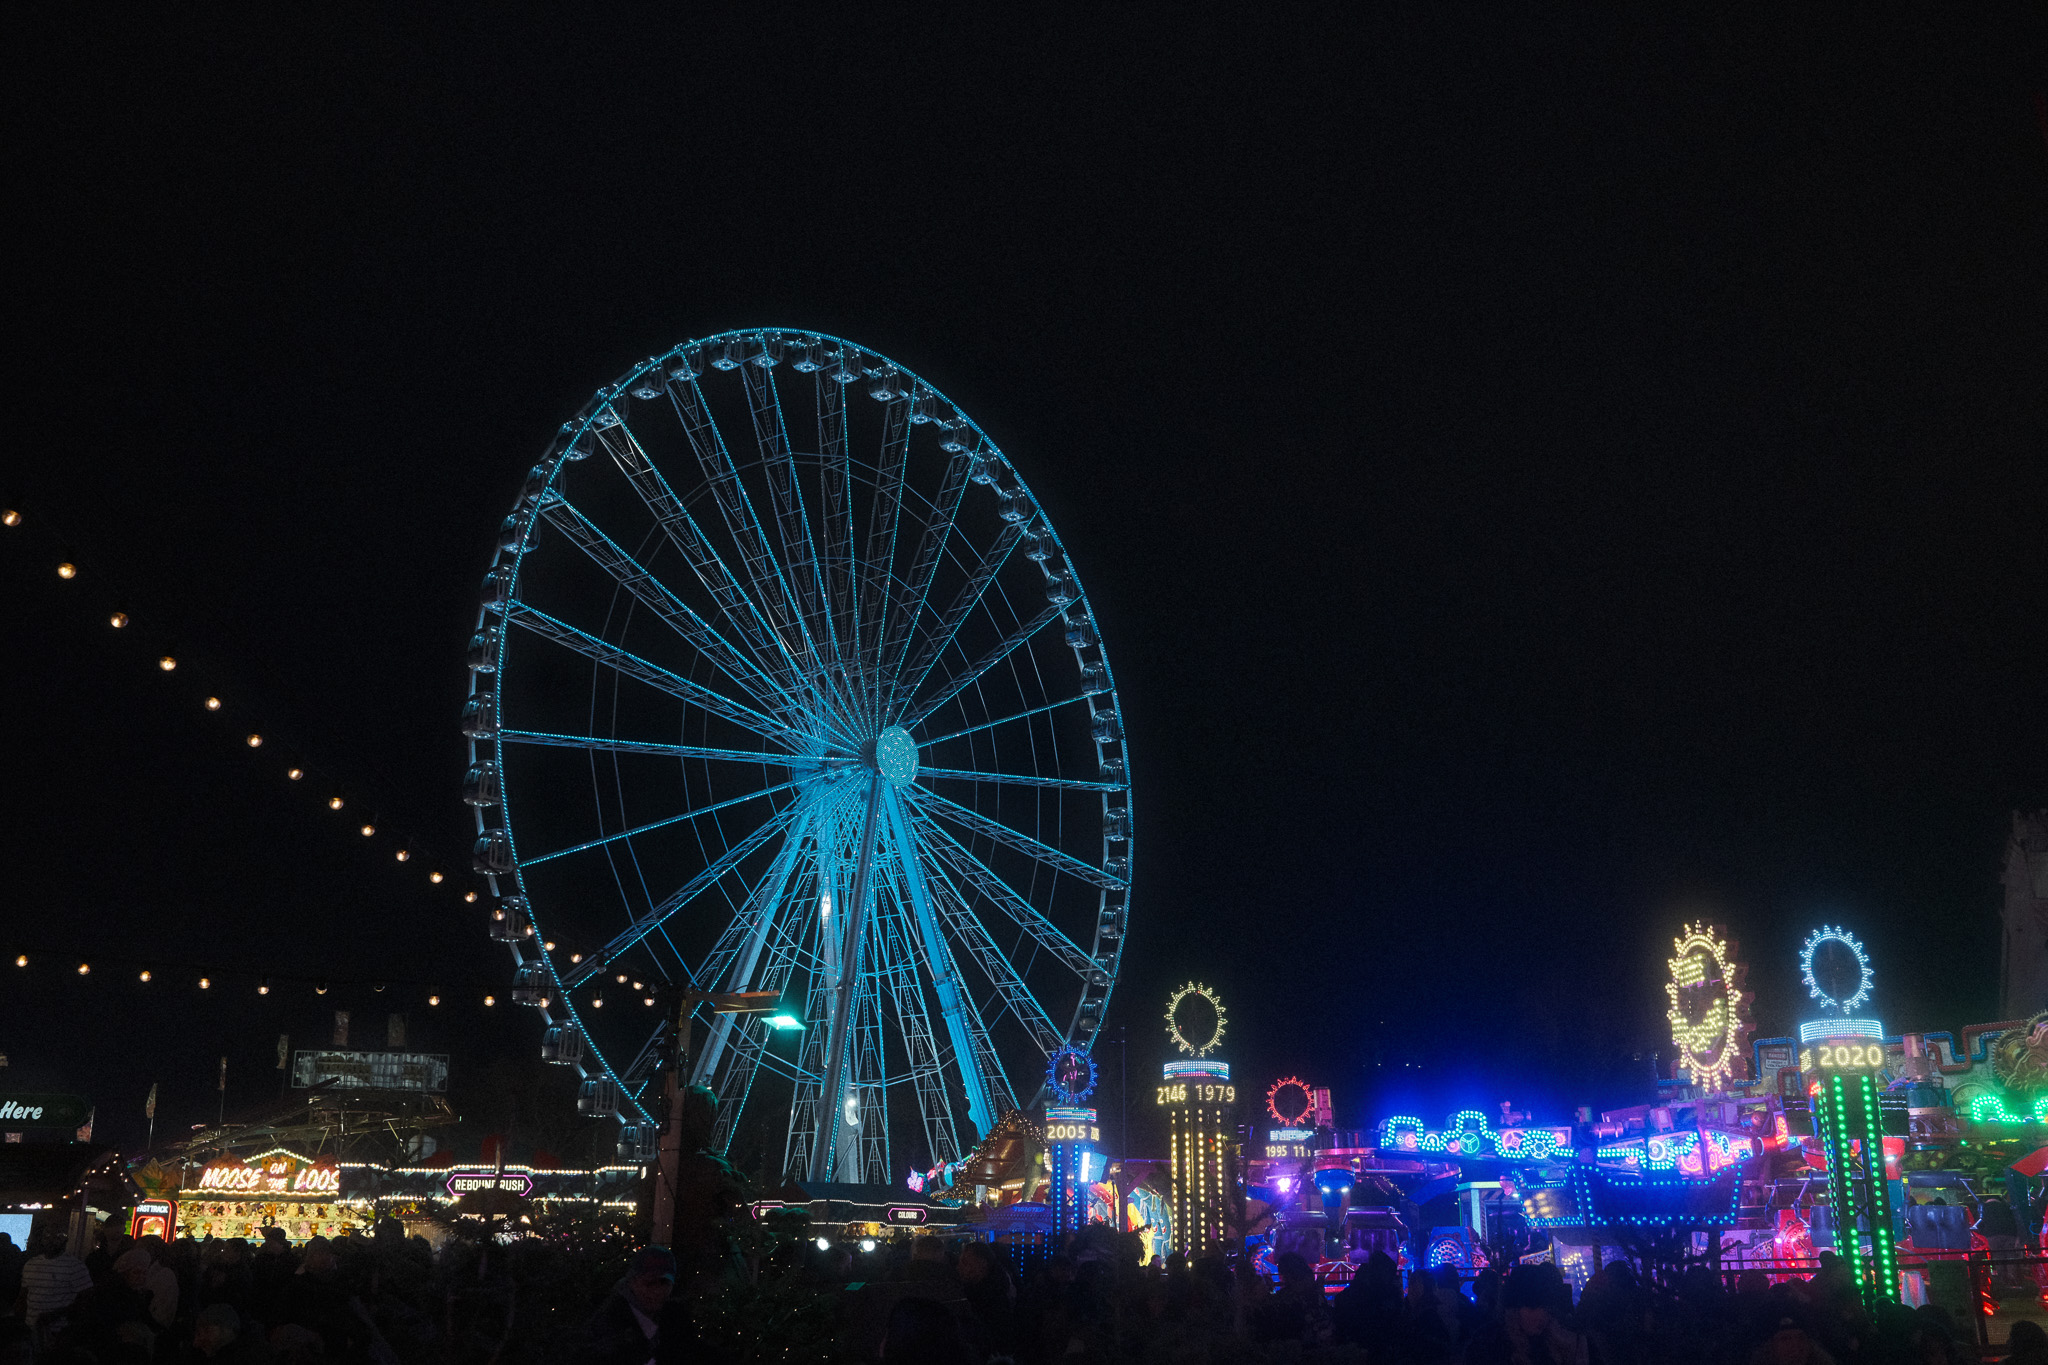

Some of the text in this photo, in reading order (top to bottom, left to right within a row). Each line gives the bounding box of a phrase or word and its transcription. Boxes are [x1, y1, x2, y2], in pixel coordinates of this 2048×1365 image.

[1819, 1045, 1883, 1067] 2020
[1157, 1084, 1187, 1105] 2146
[1196, 1084, 1236, 1103] 1979
[0, 1101, 43, 1120] Here
[1047, 1125, 1086, 1139] 2005
[1265, 1145, 1287, 1157] 1995
[199, 1167, 263, 1189] MOOSE
[269, 1161, 287, 1175] ON
[499, 1179, 525, 1191] RUSH
[898, 1211, 918, 1219] COLOURS
